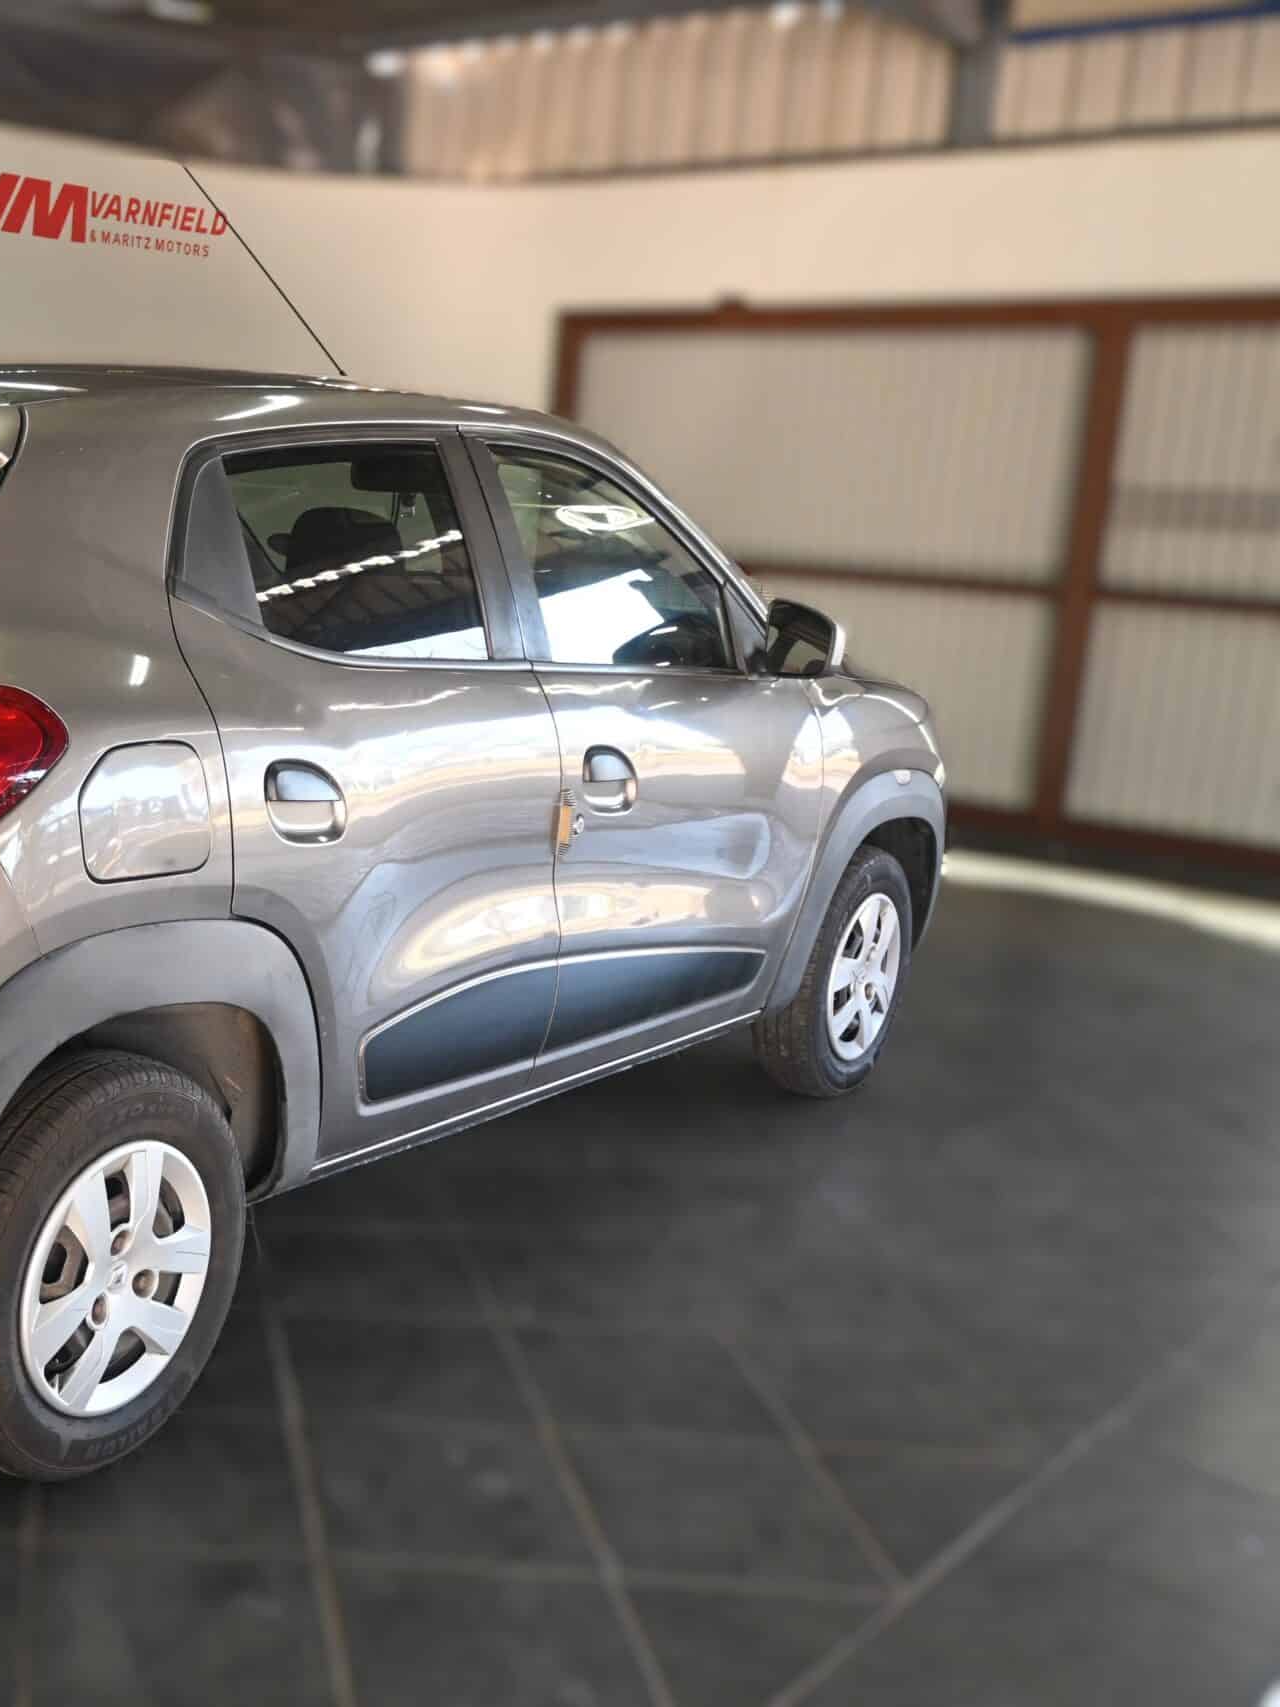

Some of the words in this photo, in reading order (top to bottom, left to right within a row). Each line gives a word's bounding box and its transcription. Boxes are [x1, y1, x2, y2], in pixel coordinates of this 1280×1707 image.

[90, 190, 229, 235] VARNFIELD
[102, 231, 152, 250] MARITZ
[155, 239, 209, 257] MOTORS
